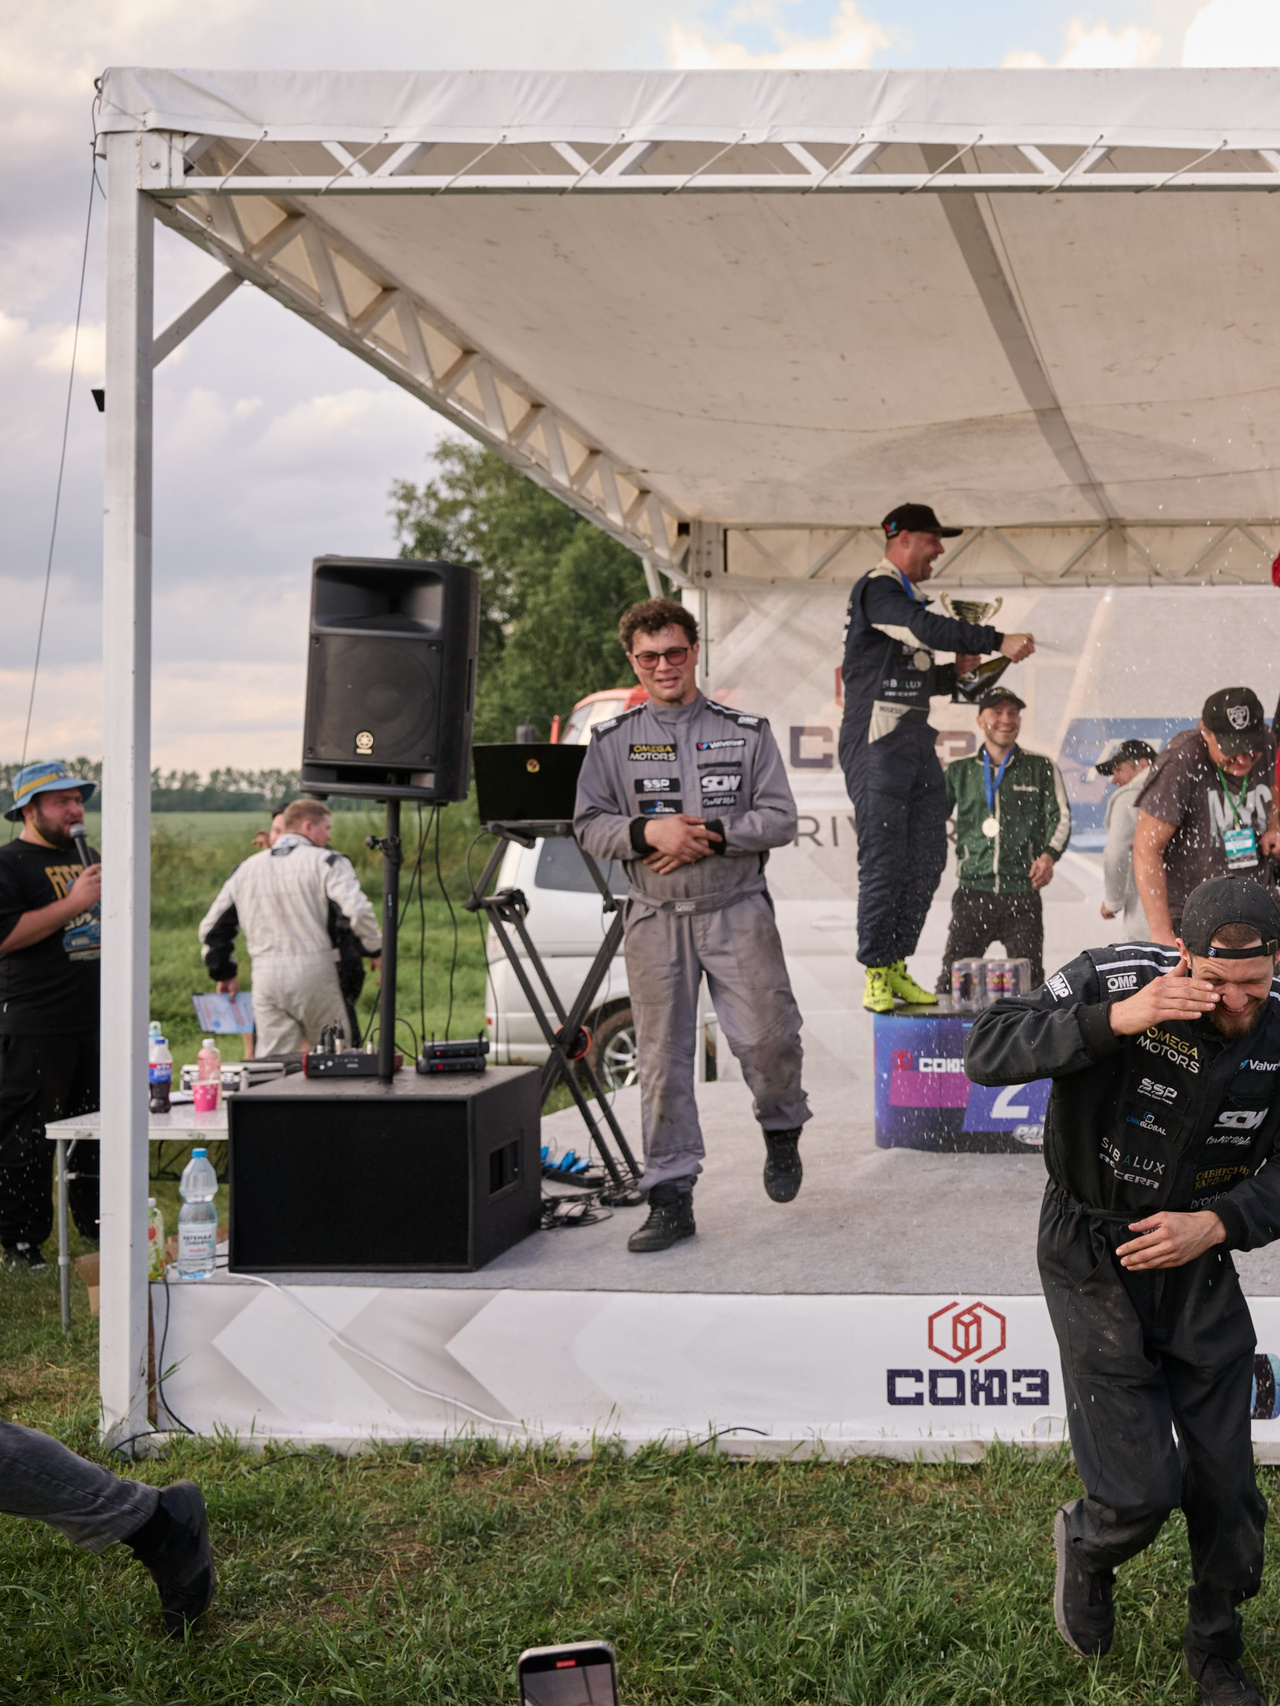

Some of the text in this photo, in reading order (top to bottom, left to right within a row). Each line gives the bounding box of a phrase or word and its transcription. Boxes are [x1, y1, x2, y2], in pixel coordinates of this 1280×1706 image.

[629, 752, 677, 761] MOTORS
[632, 744, 673, 753] OMEGA
[643, 779, 670, 787] SSP
[1048, 974, 1070, 998] MP
[1107, 975, 1137, 990] OMP
[1136, 1035, 1200, 1074] MOTORS
[1147, 1027, 1198, 1060] OMEGA
[918, 1057, 965, 1073] СОЮ
[1139, 1077, 1178, 1099] SSP
[1101, 1137, 1166, 1175] SIBALUX
[886, 1368, 1050, 1406] СОЮЗ
